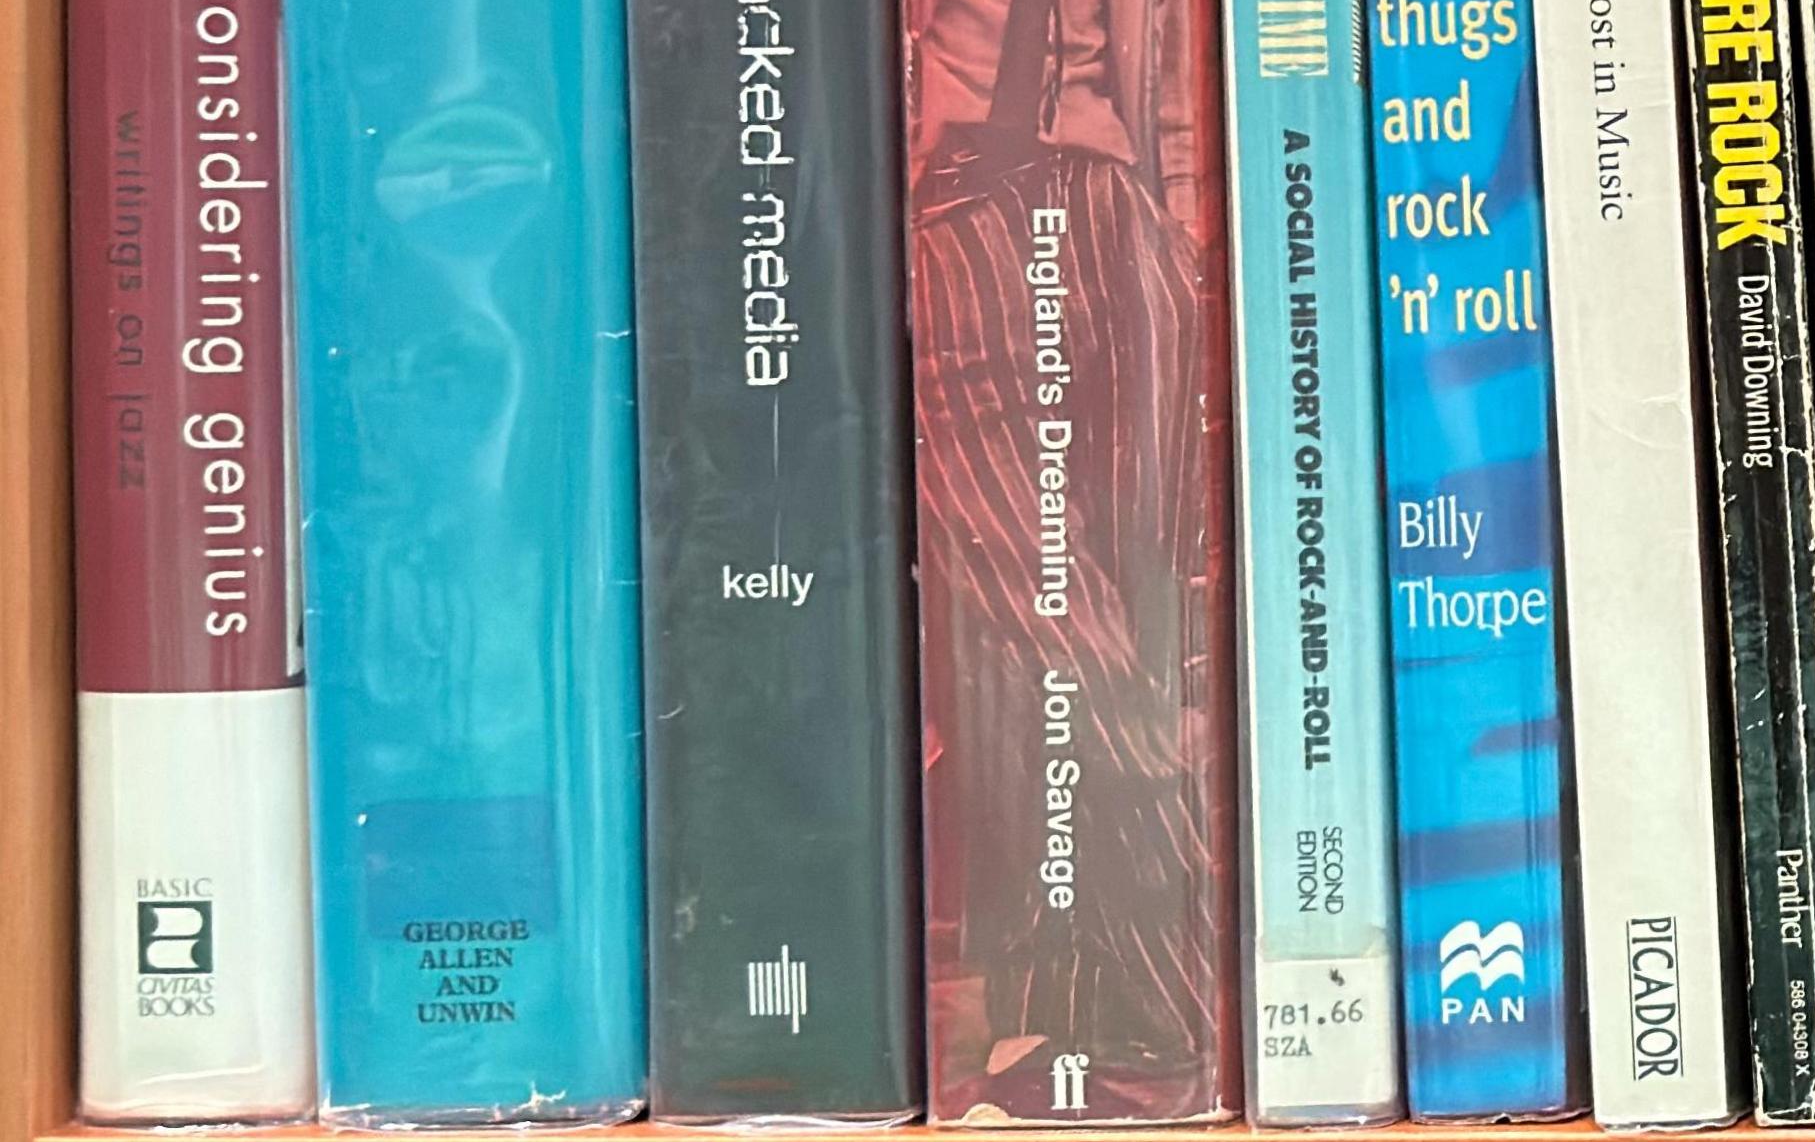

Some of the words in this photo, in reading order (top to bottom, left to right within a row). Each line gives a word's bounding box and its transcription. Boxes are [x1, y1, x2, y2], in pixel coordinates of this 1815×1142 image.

[1382, 80, 1471, 143] and
[1594, 59, 1619, 100] in
[1284, 128, 1311, 155] A
[1595, 107, 1630, 221] Music
[1706, 79, 1787, 249] ROCK
[106, 109, 144, 292] writings
[1283, 165, 1315, 283] SOCIAL
[1386, 175, 1491, 239] rock
[741, 192, 799, 385] media
[1026, 209, 1071, 406] England's
[1455, 269, 1538, 332] roll
[1738, 275, 1773, 348] David
[117, 315, 144, 367] on
[1289, 294, 1322, 448] HISTORY
[109, 394, 146, 489] jazz
[1742, 356, 1779, 468] Downing
[1295, 452, 1322, 491] OF
[184, 413, 264, 636] genius
[1035, 420, 1076, 618] Dreaming
[1400, 496, 1483, 550] Billy
[723, 565, 814, 606] kelly
[1400, 580, 1548, 635] Thorpe
[1295, 495, 1332, 770] ROCK-AND-ROLL
[1043, 670, 1078, 746] Jon
[1040, 759, 1080, 910] Savage
[137, 878, 213, 898] BASIC
[1297, 830, 1317, 913] EDITION
[1323, 825, 1344, 915] SECOND
[1776, 848, 1812, 948] Panther
[403, 919, 529, 942] GEORGE
[419, 947, 514, 969] ALLEN
[137, 977, 214, 996] CIVITAS
[138, 997, 216, 1017] BOOKS
[418, 1001, 516, 1024] UNWIN
[436, 975, 499, 996] AND
[1263, 999, 1364, 1031] 781.66
[1441, 997, 1525, 1024] PAN
[1631, 916, 1678, 1079] PICADOR
[1263, 1036, 1313, 1058] SZA
